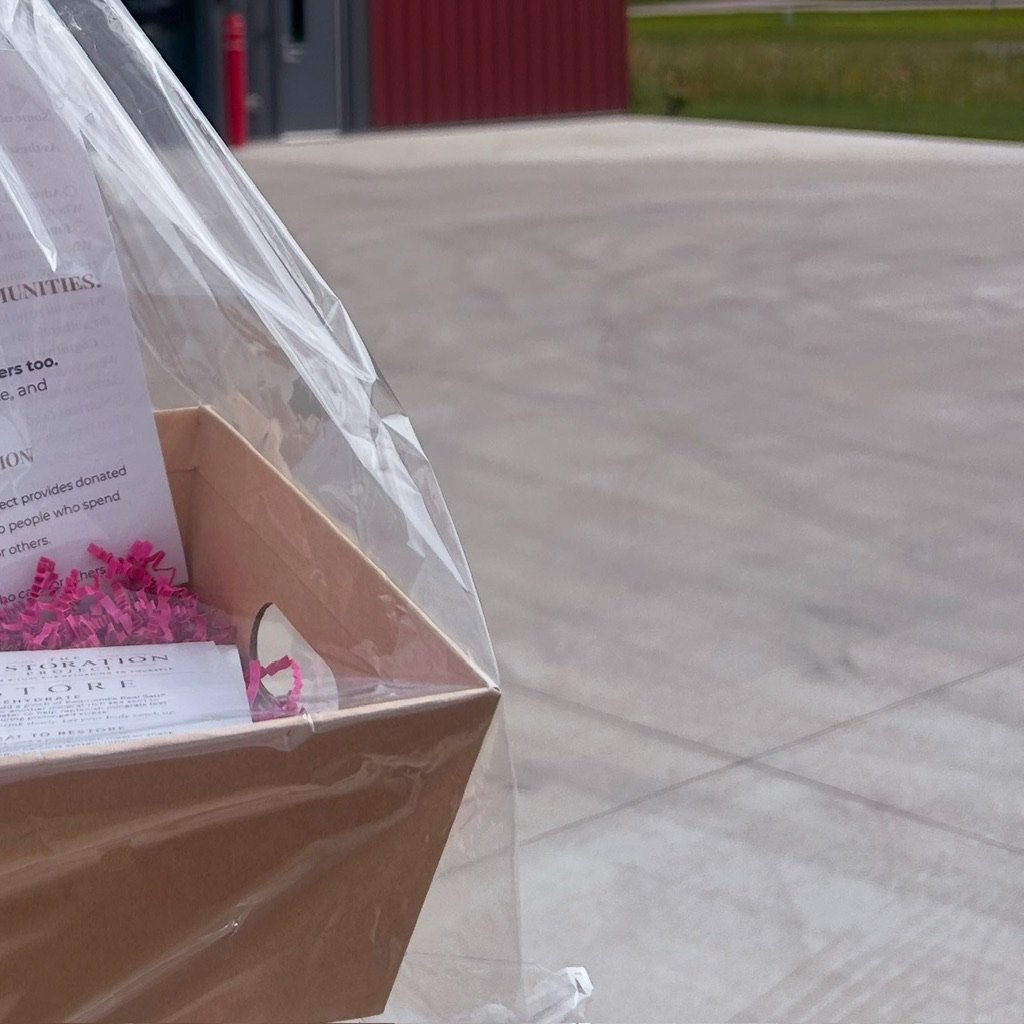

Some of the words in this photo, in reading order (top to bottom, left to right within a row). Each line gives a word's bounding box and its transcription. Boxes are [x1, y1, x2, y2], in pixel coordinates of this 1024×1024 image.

[26, 357, 58, 373] too.
[17, 378, 48, 397] and
[21, 481, 74, 507] provides
[75, 465, 128, 489] donated
[8, 511, 51, 533] people
[52, 501, 81, 519] who
[82, 490, 121, 512] spend
[8, 536, 51, 555] others.
[79, 565, 107, 581] hers
